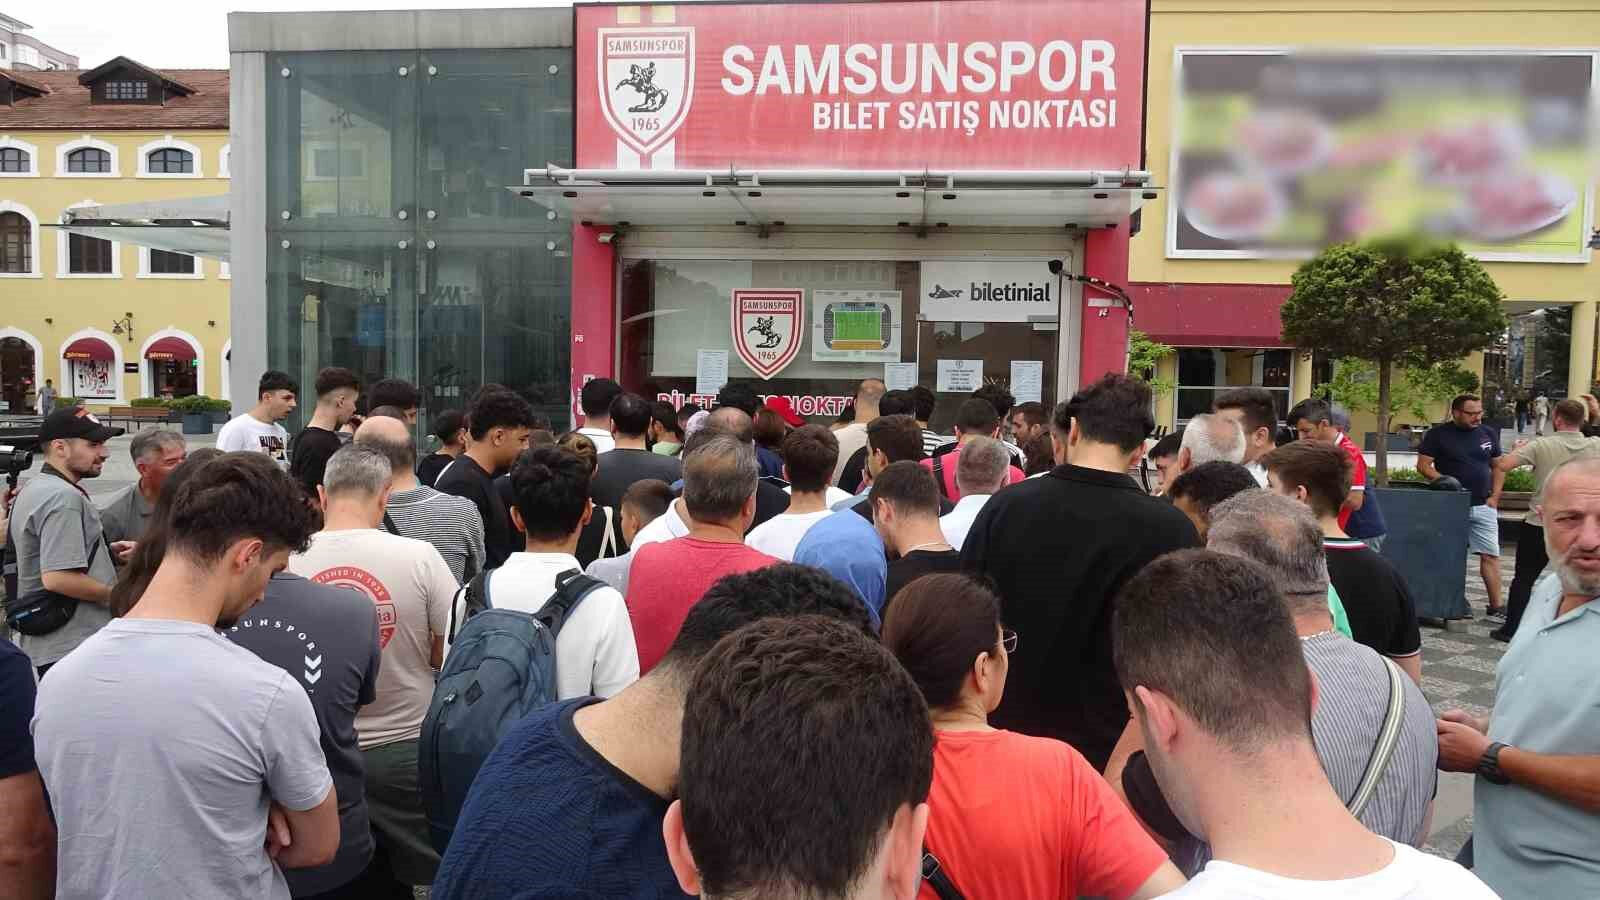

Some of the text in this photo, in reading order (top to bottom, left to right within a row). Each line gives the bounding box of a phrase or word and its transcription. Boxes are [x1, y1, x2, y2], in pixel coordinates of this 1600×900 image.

[607, 39, 685, 52] SAMSUNSPOR
[720, 39, 1118, 96] SAMSUNSPOR
[898, 100, 981, 136] SATIŞ
[988, 99, 1118, 129] NOKTASI
[631, 118, 661, 131] 1965
[969, 281, 1051, 302] biletinial
[743, 301, 793, 311] SAMSUNSPOR
[757, 350, 777, 360] 1965
